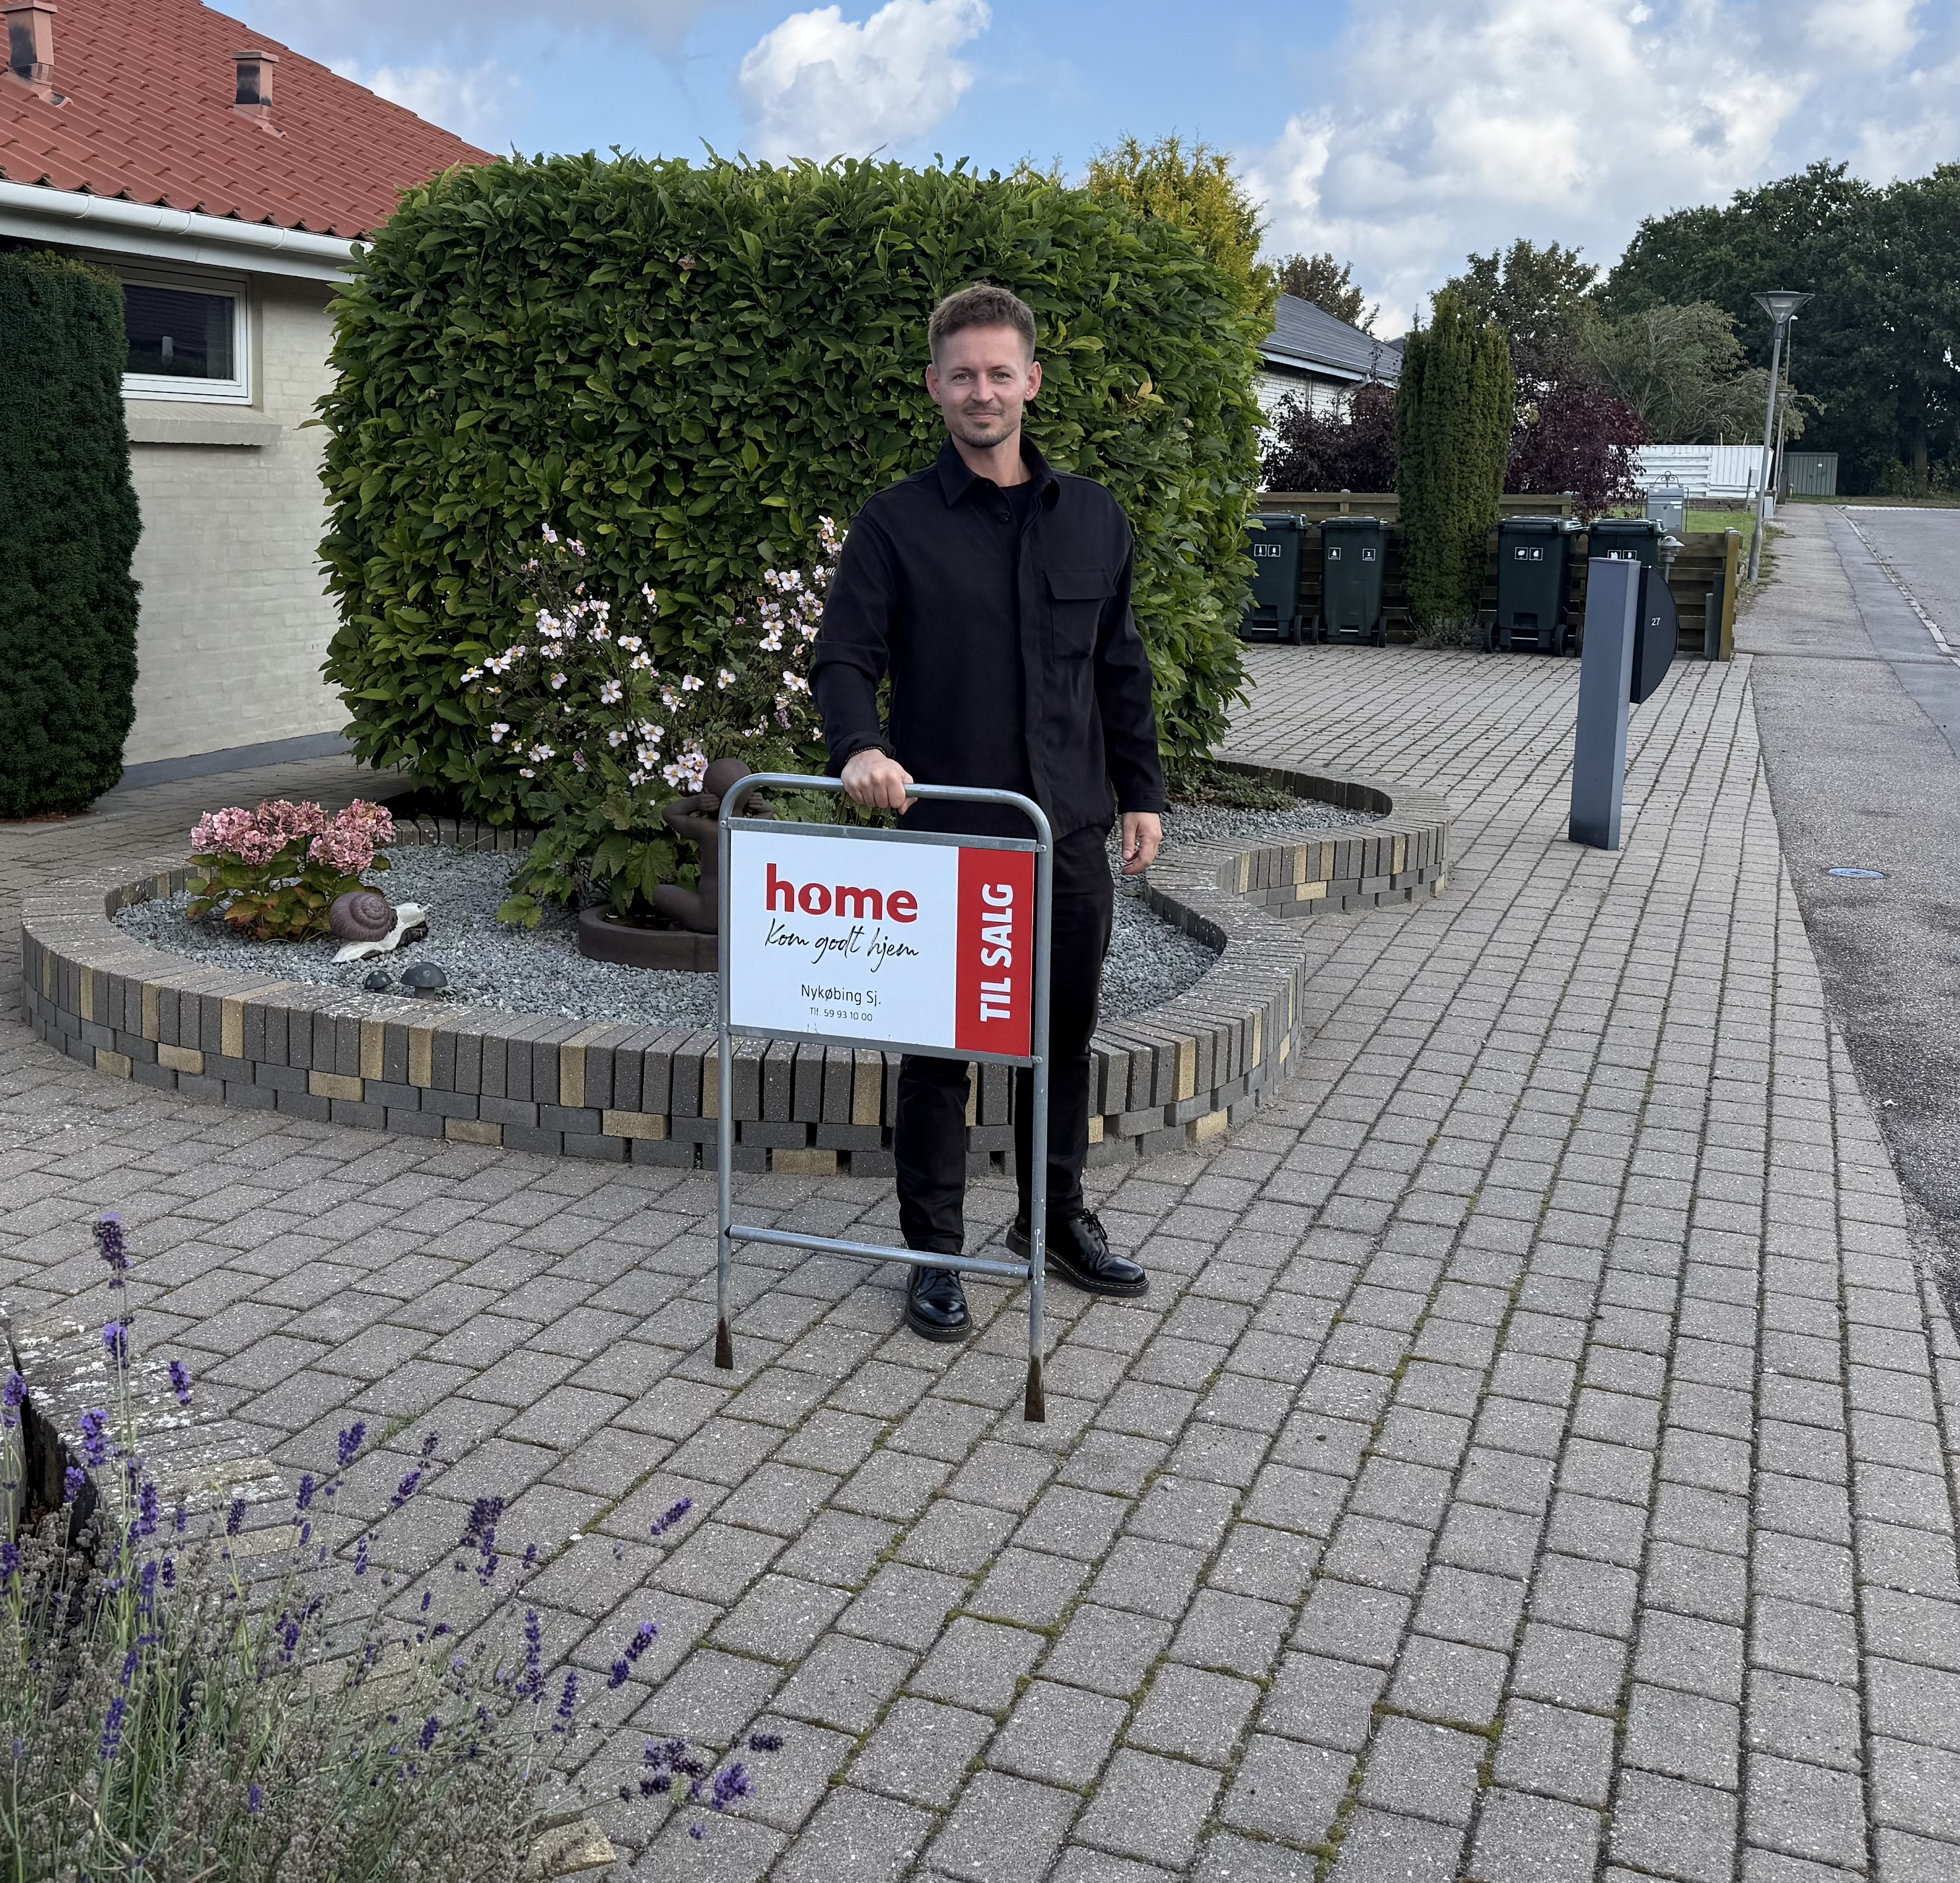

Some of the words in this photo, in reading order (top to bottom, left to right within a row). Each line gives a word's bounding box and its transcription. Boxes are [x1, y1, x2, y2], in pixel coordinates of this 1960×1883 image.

[1651, 617, 1661, 626] 27
[767, 863, 917, 923] home
[764, 917, 810, 947] Kom
[811, 925, 865, 964] godt
[867, 927, 919, 973] hjem
[980, 883, 1014, 968] SALG
[801, 984, 862, 1006] Nykøbing
[866, 990, 881, 1007] Sj.
[810, 1007, 822, 1016] Tlf.
[824, 1008, 835, 1018] 59
[836, 1010, 847, 1019] 93
[850, 1011, 859, 1020] 10
[861, 1012, 873, 1022] 00
[979, 977, 1011, 1023] TIL
